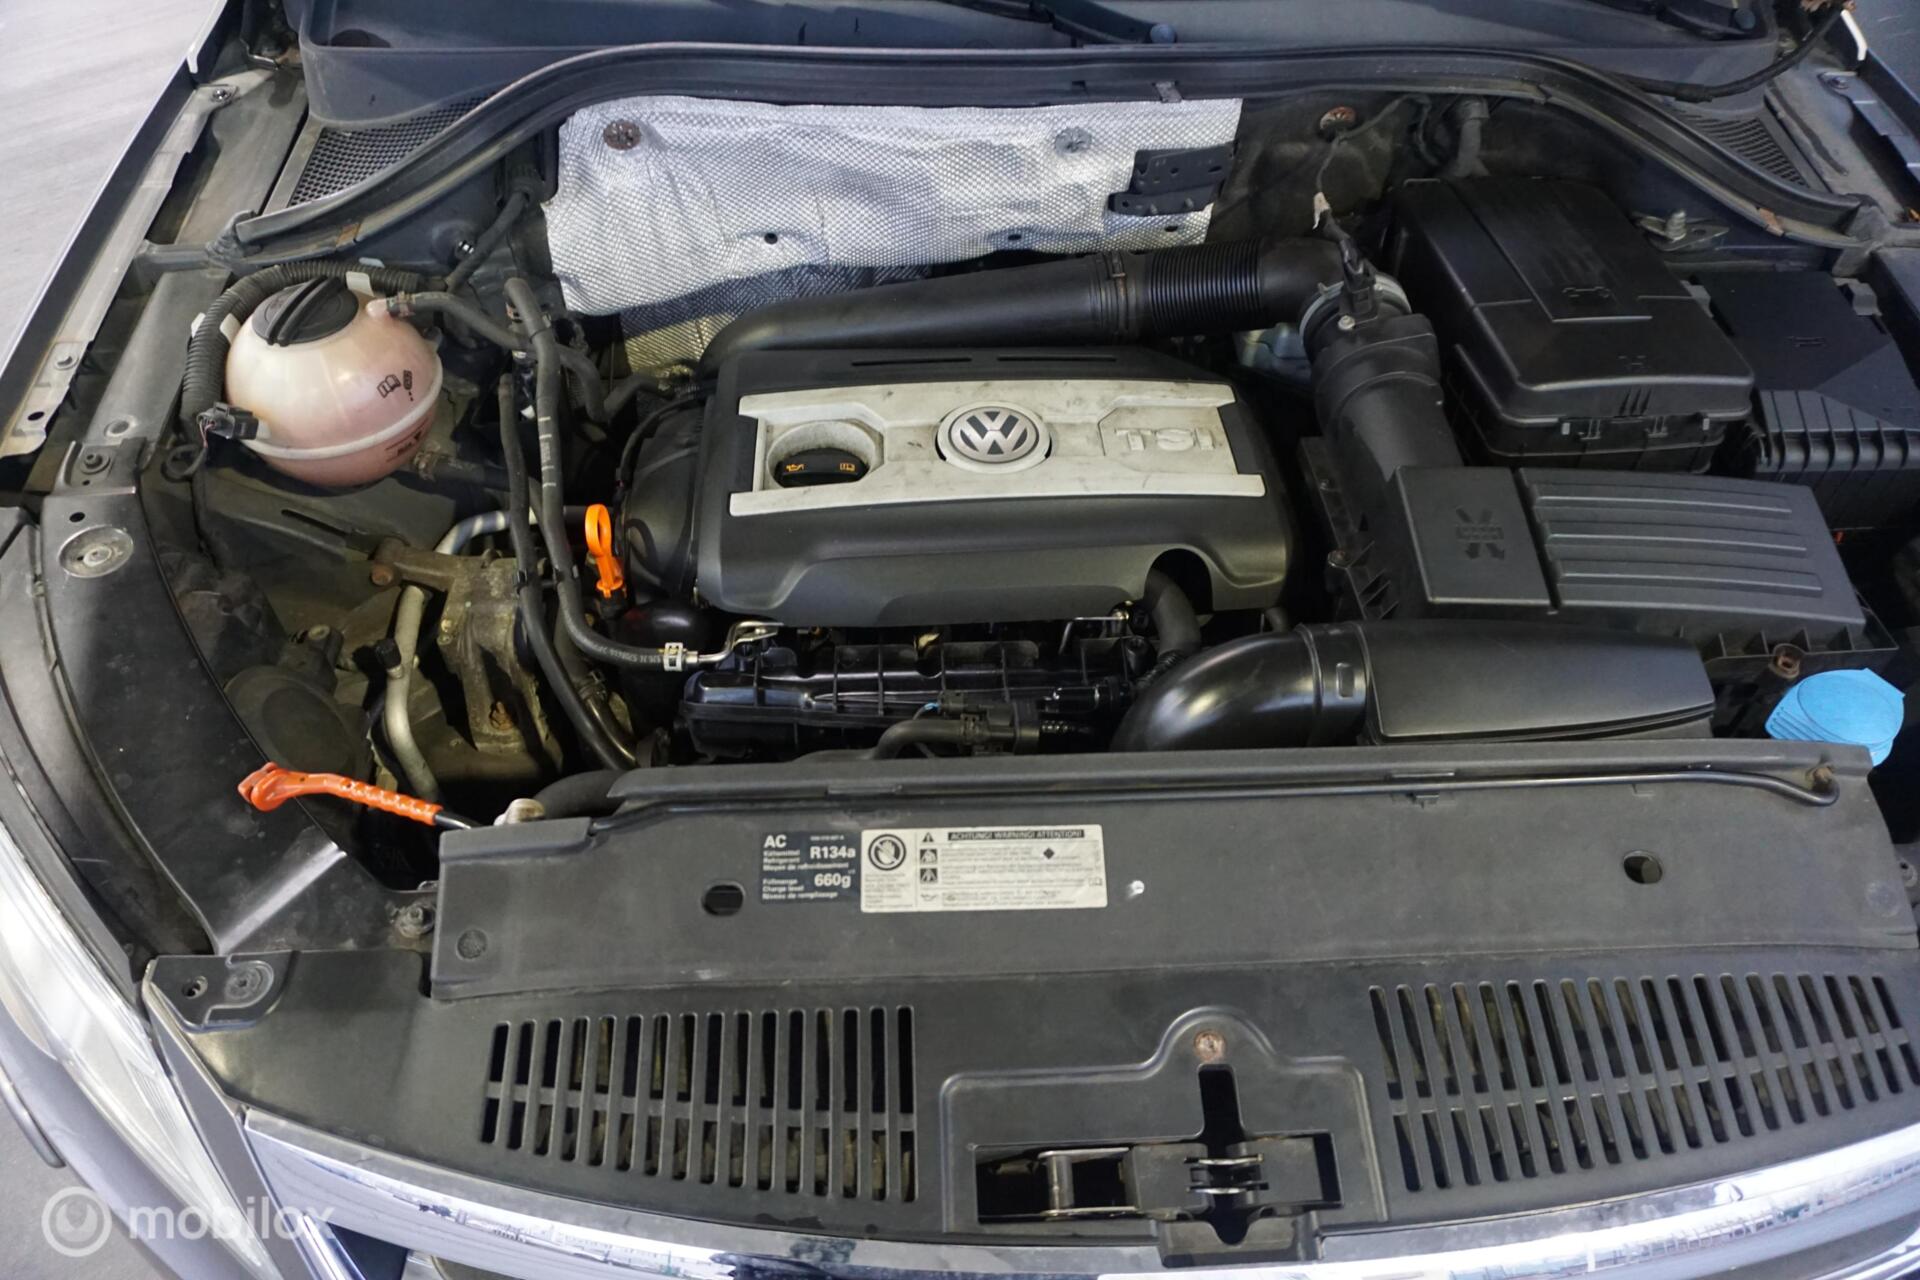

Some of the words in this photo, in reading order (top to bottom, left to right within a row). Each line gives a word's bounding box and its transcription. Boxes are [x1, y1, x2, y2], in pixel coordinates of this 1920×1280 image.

[950, 408, 1037, 462] VW
[1114, 427, 1215, 451] TSI
[763, 834, 787, 849] AC
[810, 845, 856, 859] R134a
[814, 873, 851, 888] 660g
